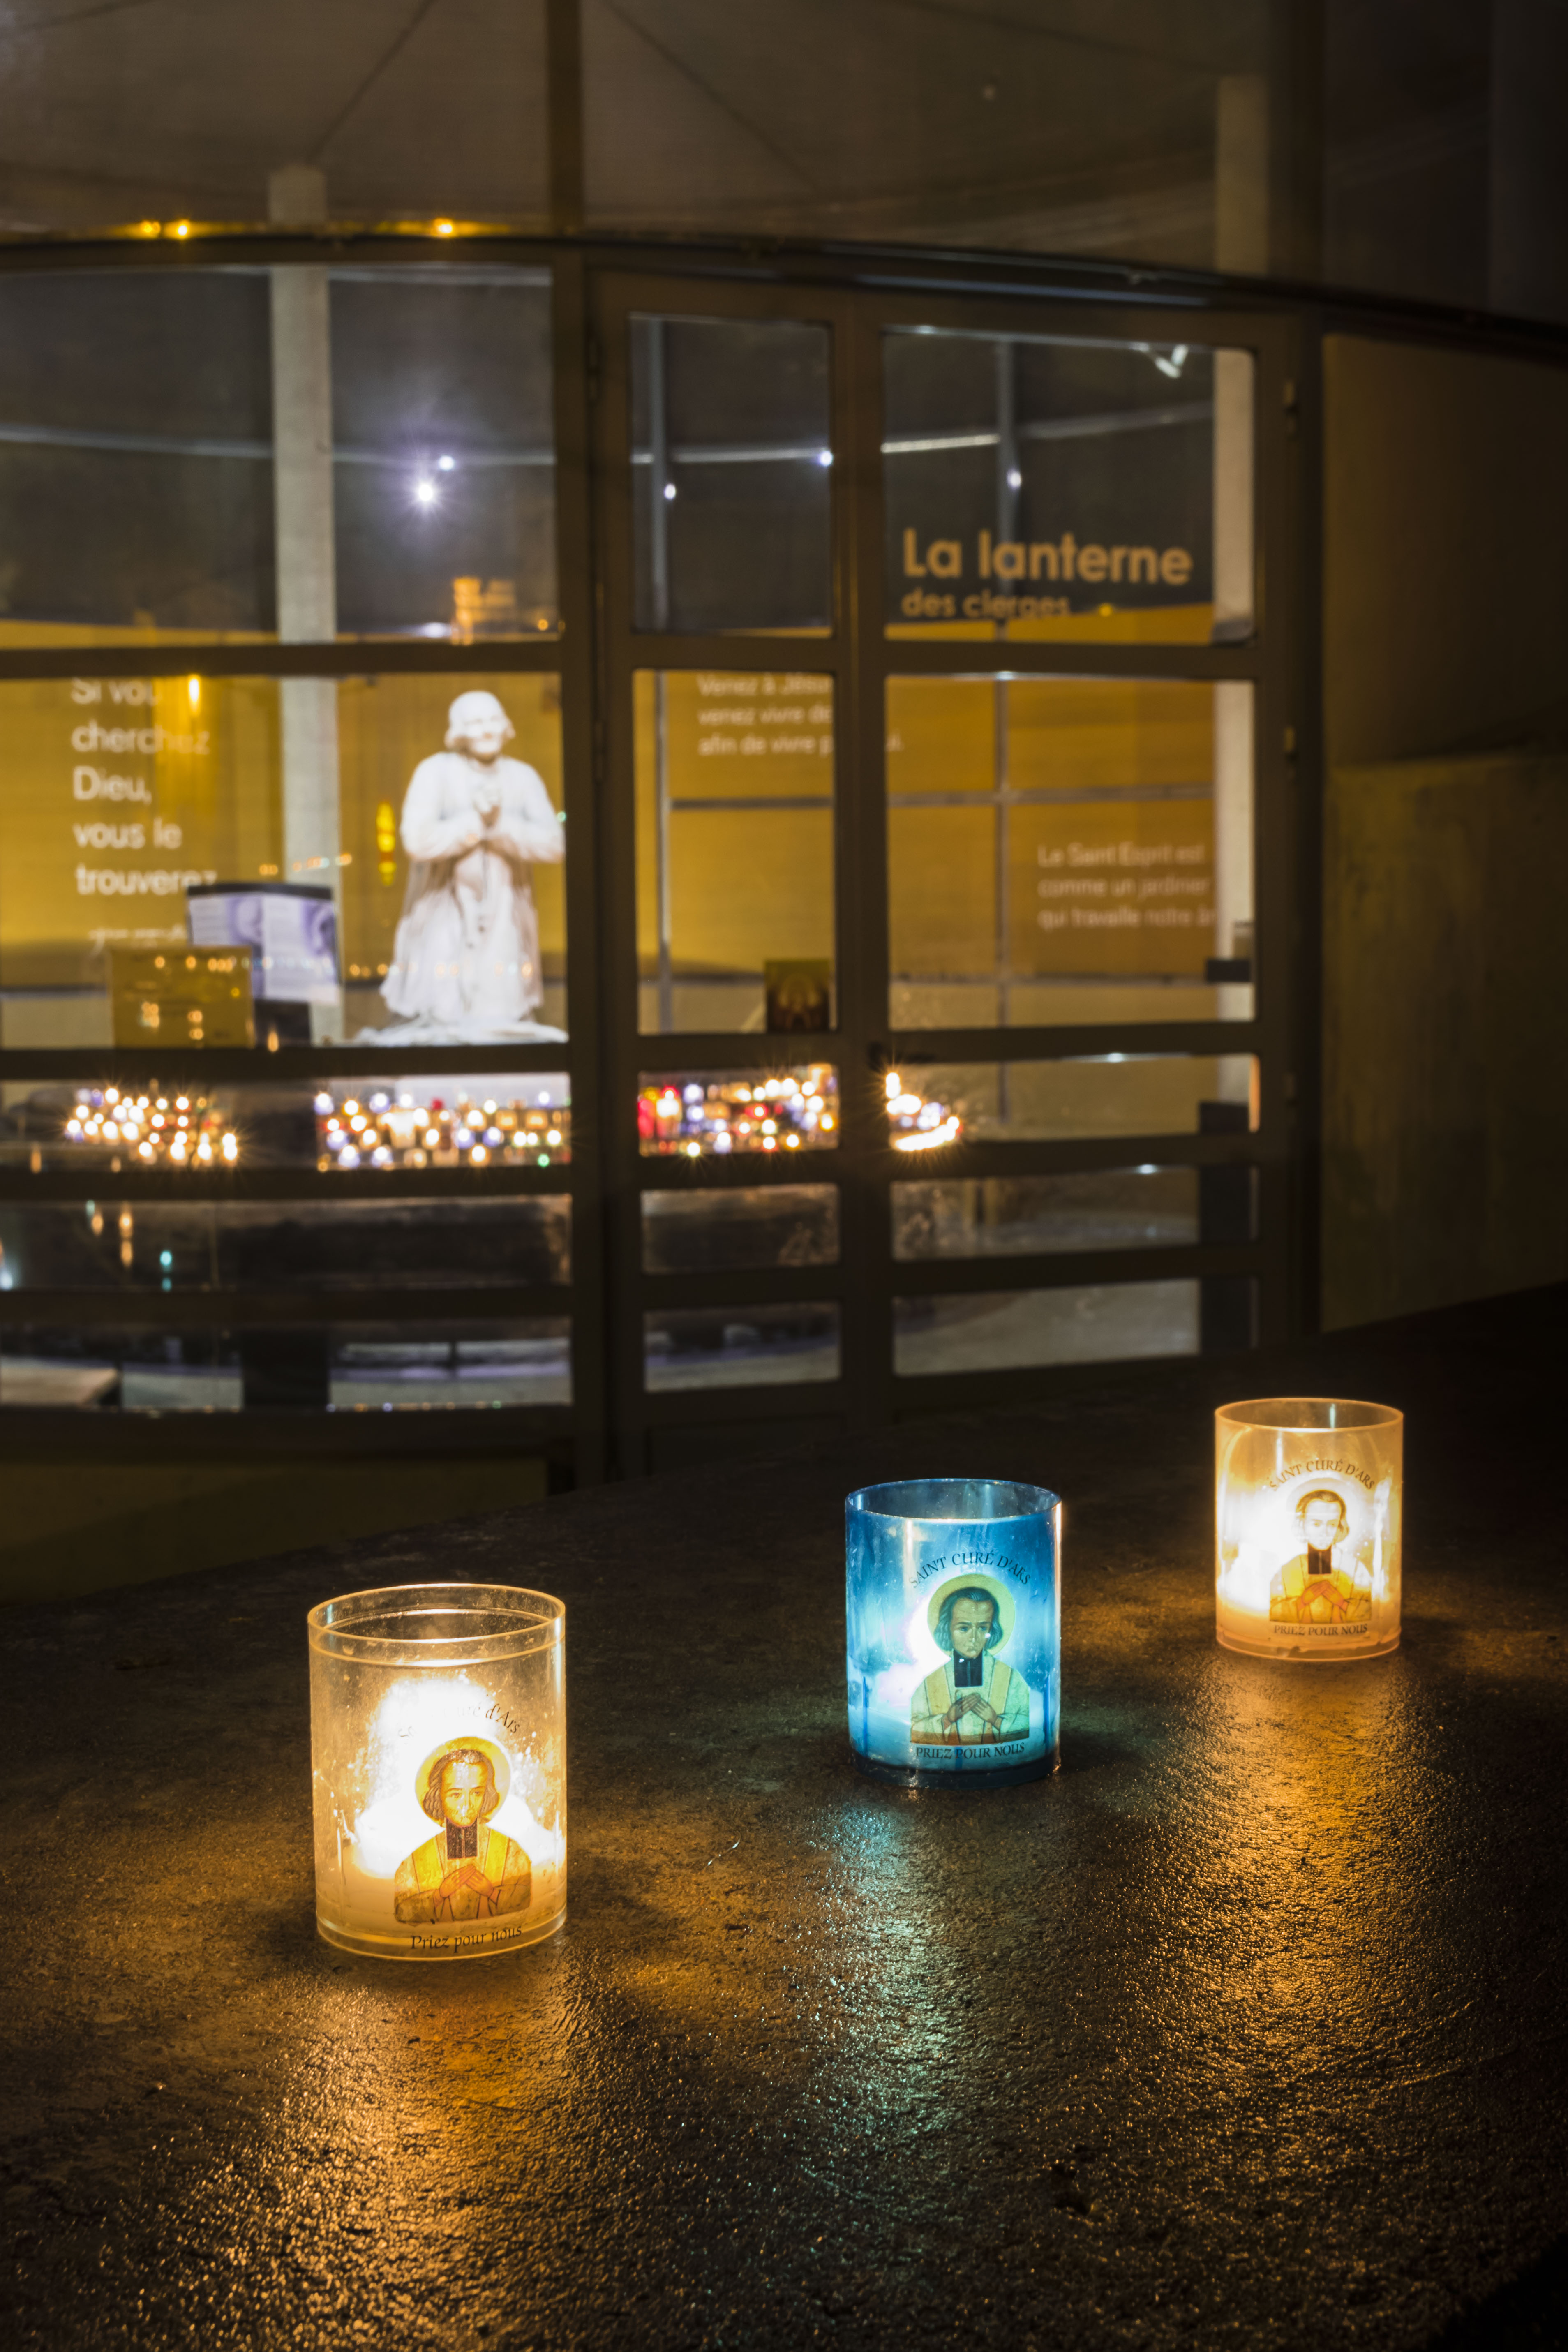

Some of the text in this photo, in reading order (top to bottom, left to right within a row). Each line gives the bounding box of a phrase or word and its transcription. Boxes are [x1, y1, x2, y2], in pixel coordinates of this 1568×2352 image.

[904, 527, 1194, 584] La lanterne
[901, 587, 1069, 621] des cierges
[71, 719, 211, 755] cherchez
[740, 734, 767, 756] de
[73, 765, 152, 804] Dieu,
[73, 818, 182, 849] vous le
[1306, 1459, 1343, 1472] CURÉ
[1345, 1463, 1375, 1490] D'ARS
[909, 1550, 1031, 1588] SAINT CURÉ D'ARS
[1274, 1623, 1367, 1636] PRIEZ POUR NOUS
[485, 1703, 520, 1733] d'Ars
[916, 1742, 1024, 1759] PRIEZ POUR NOUS
[411, 1926, 522, 1953] Priez pour nous
